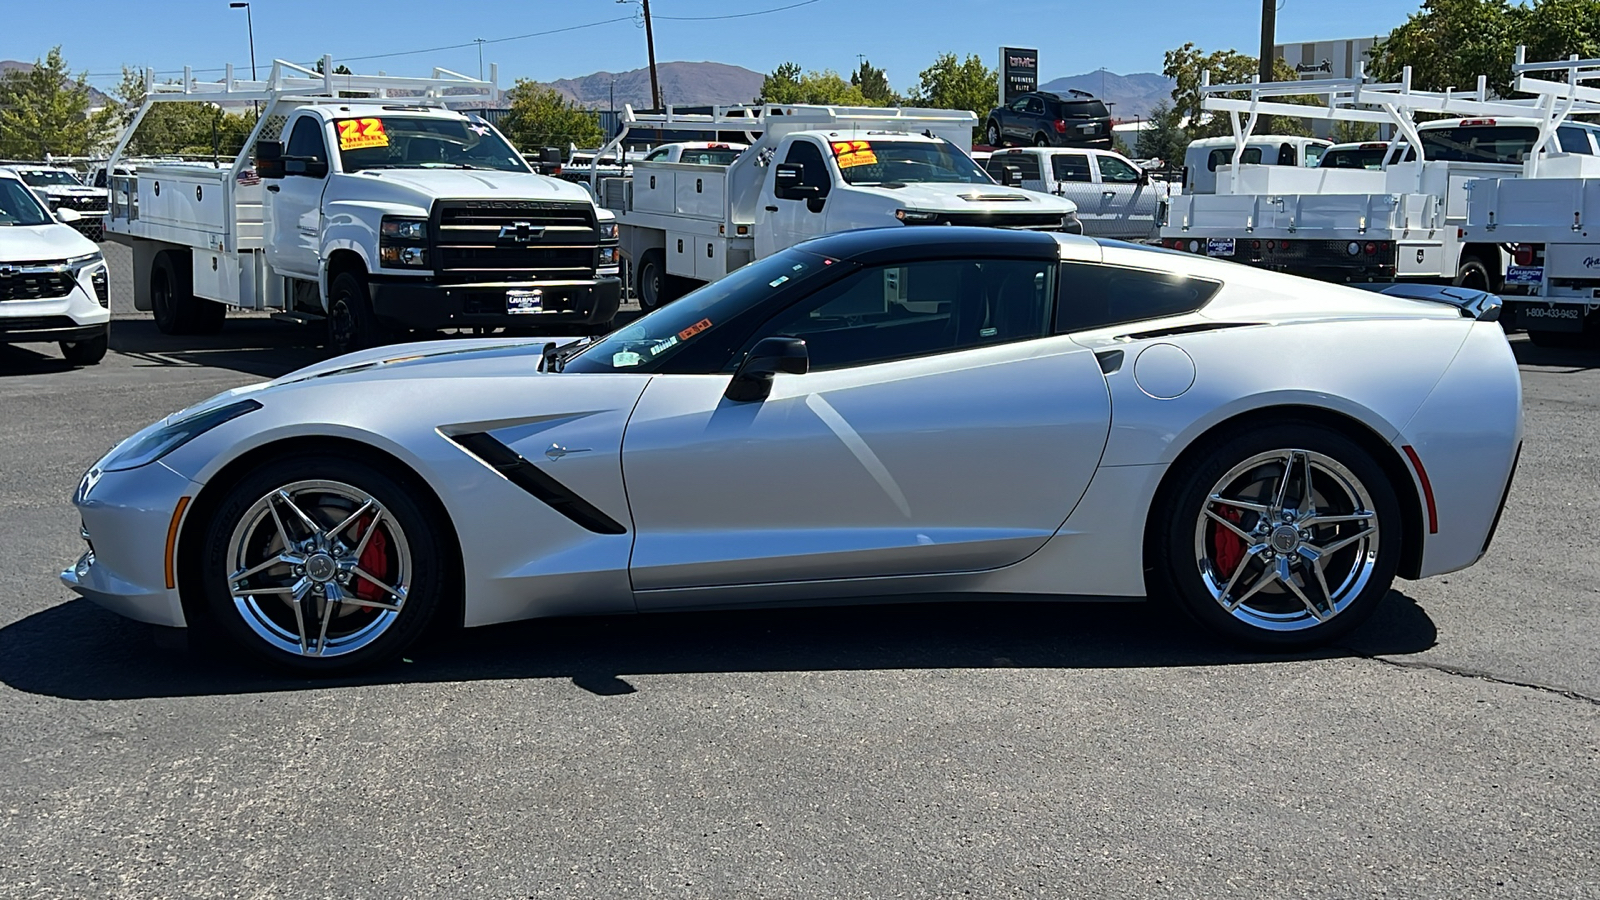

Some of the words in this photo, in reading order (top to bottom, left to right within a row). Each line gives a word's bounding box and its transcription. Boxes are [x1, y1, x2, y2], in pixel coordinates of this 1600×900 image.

[1010, 56, 1035, 67] GMC
[338, 118, 382, 138] 22
[346, 135, 384, 143] DIESEL
[834, 141, 871, 157] 22
[466, 201, 572, 210] CHEVROLET
[1526, 308, 1578, 319] 1-800-433-9452
